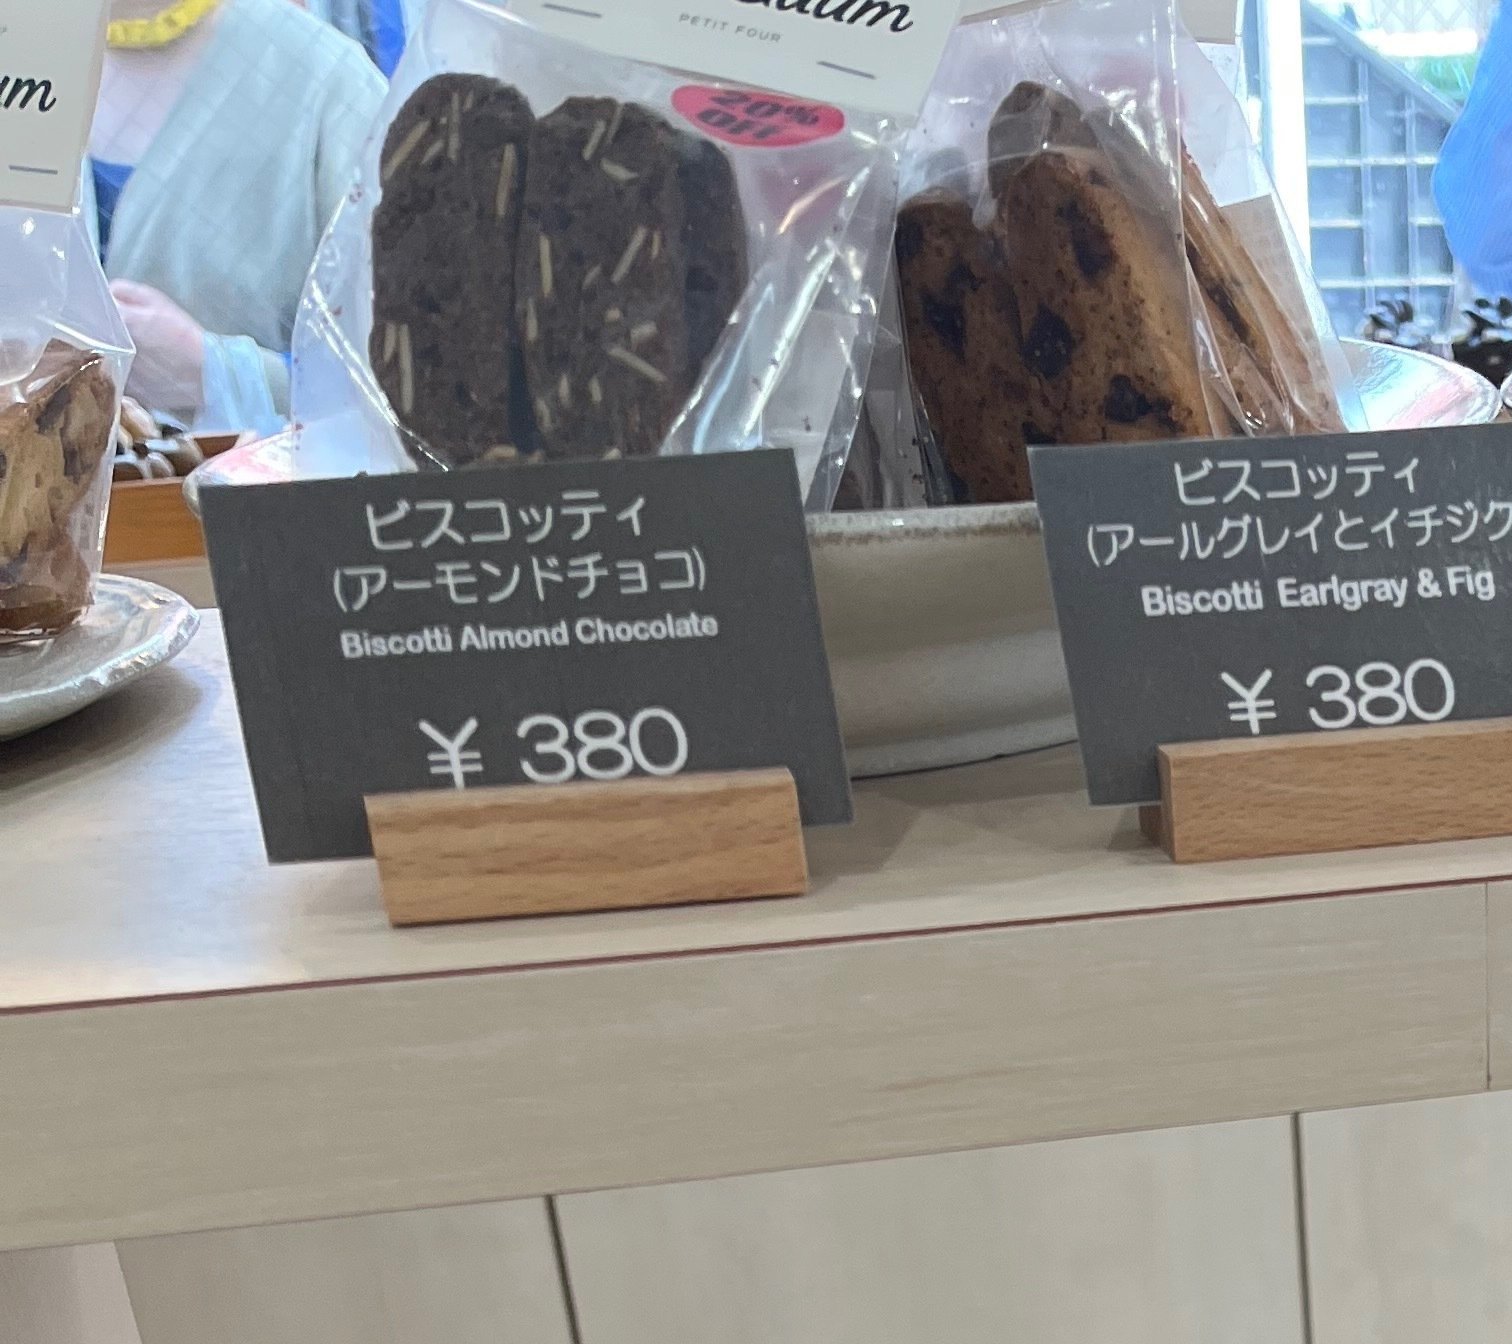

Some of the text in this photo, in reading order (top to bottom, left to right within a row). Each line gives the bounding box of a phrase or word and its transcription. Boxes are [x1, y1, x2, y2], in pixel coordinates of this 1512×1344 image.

[678, 12, 782, 44] PETIT FOUR
[1173, 450, 1420, 506] ビスコッティ
[365, 489, 645, 551] ビスコッティ
[333, 545, 706, 613] (アーモンドチョコ)
[1140, 565, 1496, 617] Biscotti Earlgray & Fig
[339, 612, 720, 659] Biscotti Almond Chocolate
[1304, 657, 1456, 730] 380
[516, 705, 689, 784] 380
